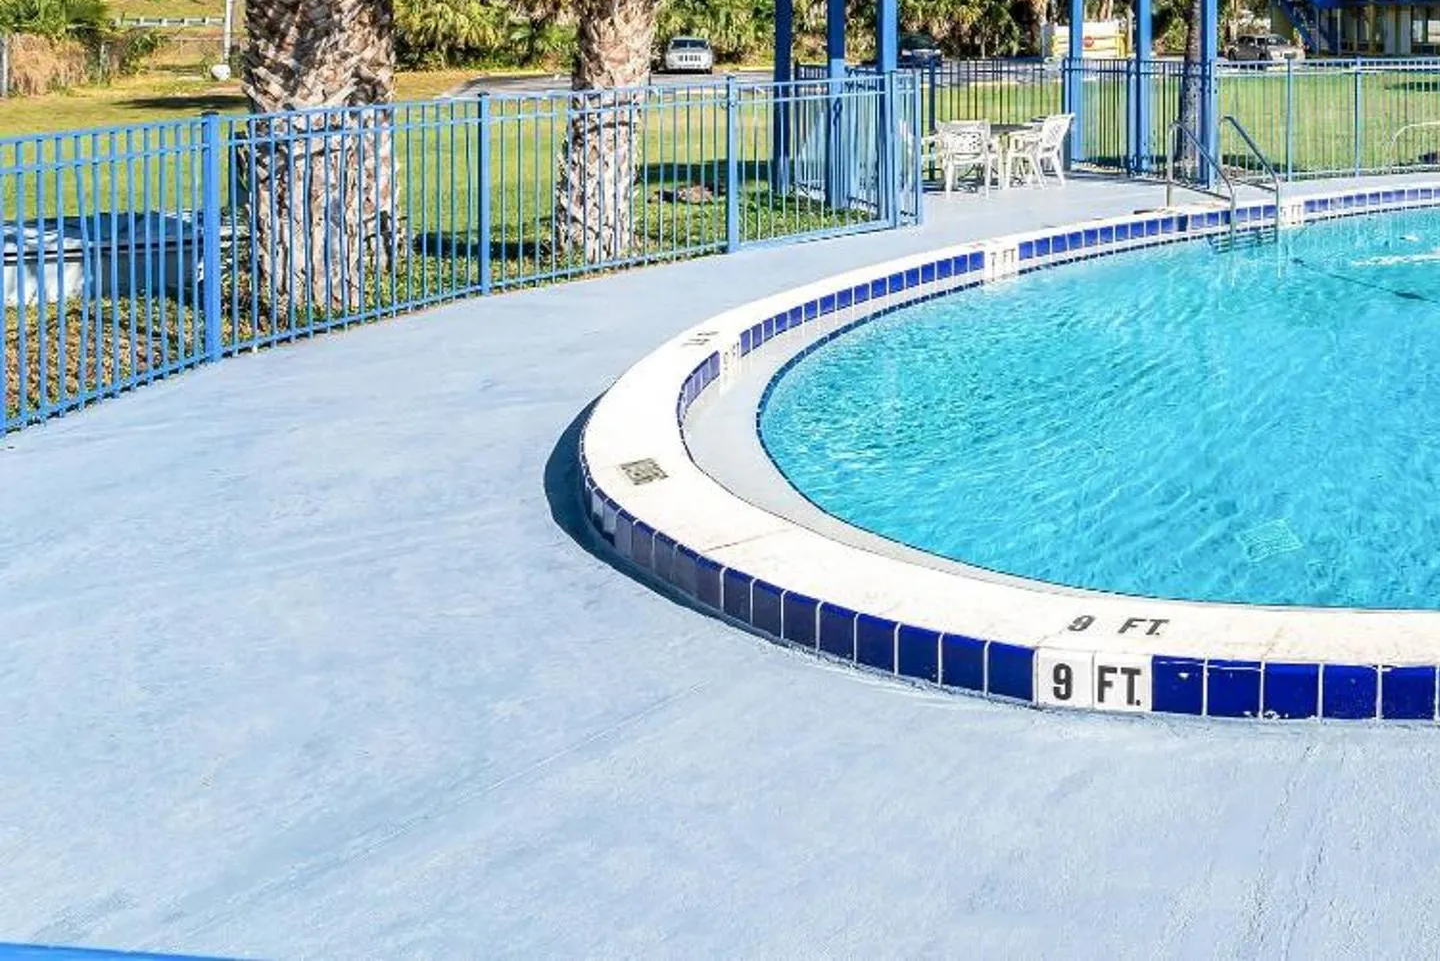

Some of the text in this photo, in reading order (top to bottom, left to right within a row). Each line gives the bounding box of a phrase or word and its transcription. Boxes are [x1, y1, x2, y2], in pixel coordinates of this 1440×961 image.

[1067, 614, 1170, 636] 9 FT.
[1052, 662, 1142, 706] 9 FT.
